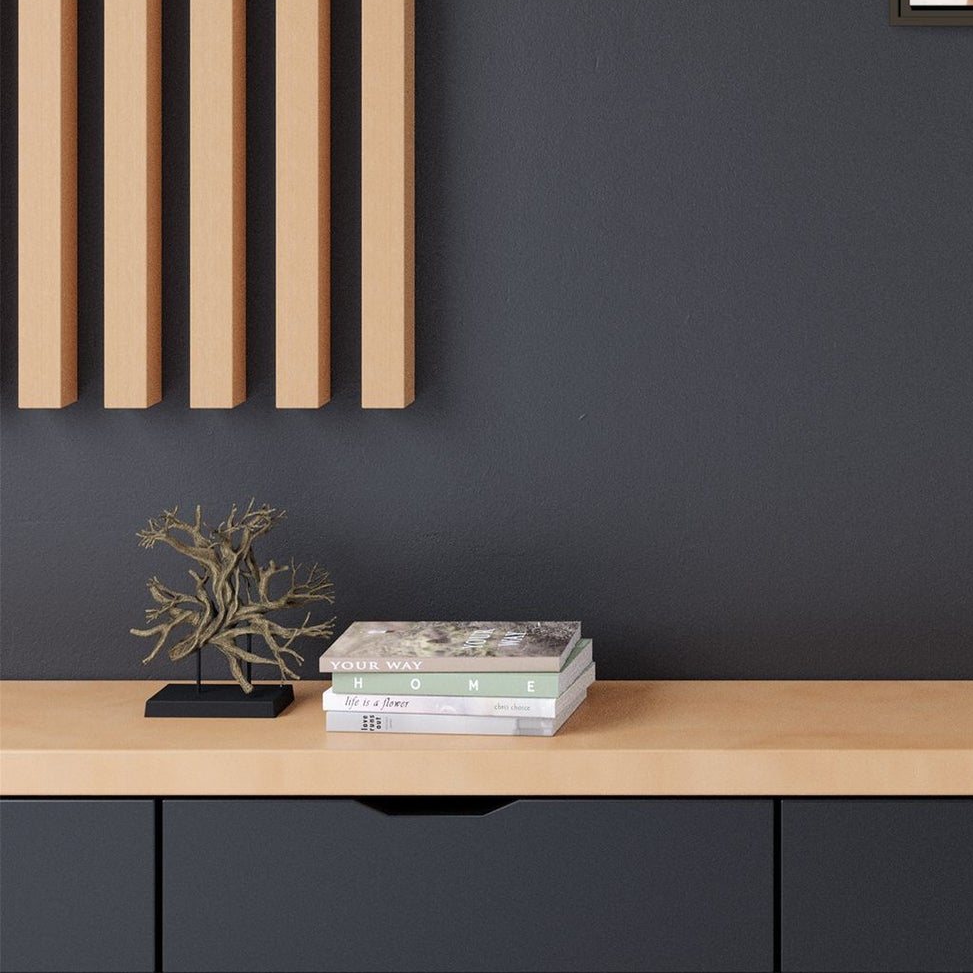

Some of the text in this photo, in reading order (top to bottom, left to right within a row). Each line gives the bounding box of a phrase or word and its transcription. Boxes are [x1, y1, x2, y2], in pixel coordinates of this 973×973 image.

[331, 661, 422, 670] YOUR WAY
[345, 696, 360, 710] life
[363, 698, 371, 707] is
[380, 697, 410, 710] flower
